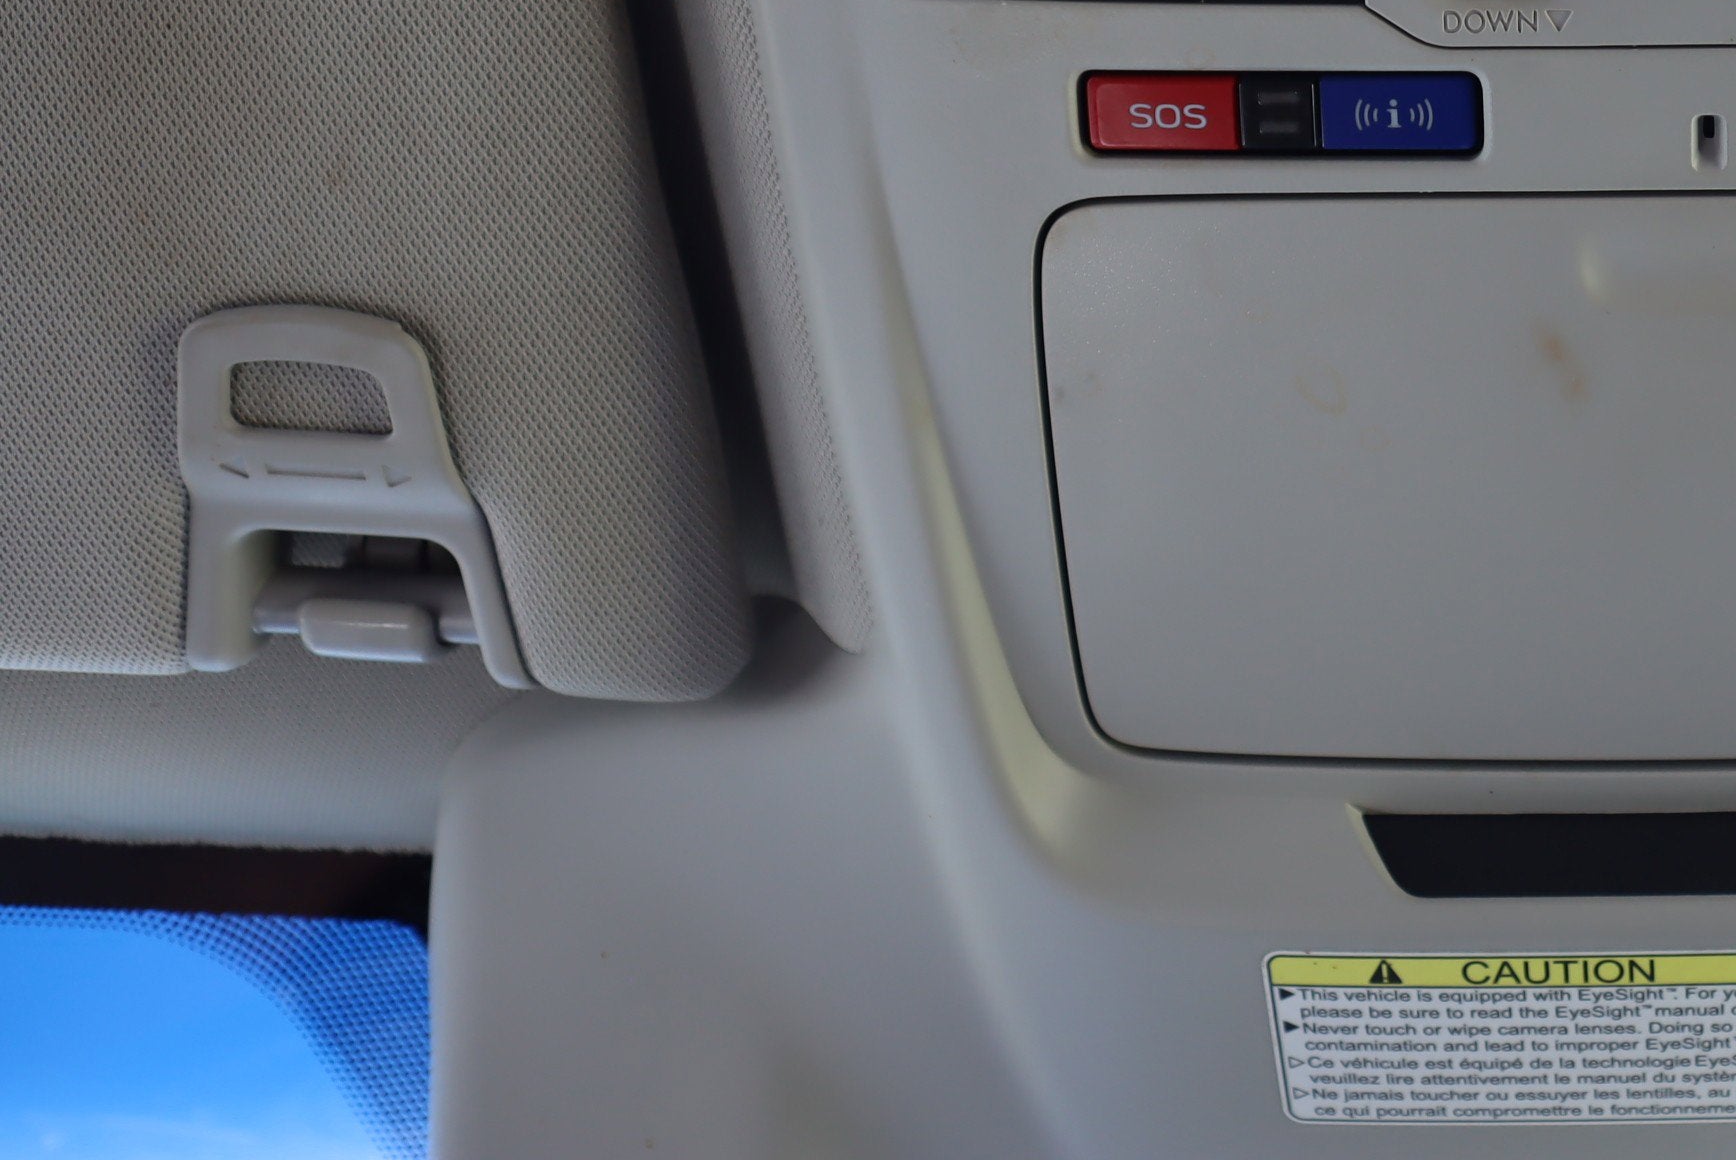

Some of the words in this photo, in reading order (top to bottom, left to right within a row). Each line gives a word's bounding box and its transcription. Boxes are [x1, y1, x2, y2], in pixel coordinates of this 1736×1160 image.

[1443, 9, 1538, 34] DOWN
[1129, 103, 1208, 129] SOS
[1461, 959, 1656, 985] CAUTION
[1300, 989, 1338, 1002] This
[1344, 989, 1411, 1002] vehicle
[1417, 989, 1431, 1002] is
[1439, 989, 1527, 1004] equipped
[1533, 989, 1571, 1002] with
[1685, 987, 1716, 1000] For
[1301, 1006, 1362, 1020] please
[1369, 1006, 1392, 1019] be
[1399, 1008, 1439, 1019] sure
[1446, 1007, 1463, 1019] to
[1471, 1006, 1512, 1019] read
[1519, 1006, 1548, 1019] the
[1655, 1004, 1724, 1017] manual
[1303, 1022, 1358, 1035] Never
[1365, 1023, 1417, 1036] touch
[1423, 1025, 1441, 1035] or
[1447, 1023, 1491, 1038] wipe
[1498, 1024, 1568, 1036] camera
[1575, 1022, 1641, 1035] lenses.
[1649, 1021, 1704, 1035] Doing
[1711, 1022, 1732, 1033] so
[1305, 1040, 1436, 1052] contamination
[1443, 1040, 1478, 1052] and
[1485, 1040, 1524, 1052] lead
[1531, 1040, 1549, 1052] to
[1555, 1039, 1639, 1054] improper
[1307, 1056, 1334, 1069] Ce
[1340, 1056, 1418, 1070] véhicule
[1425, 1058, 1453, 1069] est
[1459, 1057, 1523, 1072] équipé
[1529, 1057, 1553, 1070] de
[1559, 1057, 1575, 1069] la
[1583, 1055, 1691, 1070] technologie
[1309, 1073, 1379, 1086] veuillez
[1386, 1073, 1415, 1086] lire
[1421, 1072, 1548, 1086] attentivement
[1554, 1072, 1570, 1085] le
[1577, 1071, 1646, 1084] manuel
[1653, 1071, 1675, 1083] du
[1312, 1089, 1338, 1101] Ne
[1344, 1089, 1404, 1103] jamais
[1411, 1089, 1479, 1101] toucher
[1486, 1091, 1508, 1101] ou
[1515, 1090, 1587, 1102] essuyer
[1593, 1088, 1620, 1100] les
[1708, 1088, 1730, 1098] au
[1314, 1105, 1336, 1116] ce
[1342, 1104, 1370, 1118] qui
[1376, 1104, 1447, 1118] pourrait
[1453, 1104, 1582, 1118] compromettre
[1589, 1104, 1606, 1116] le
